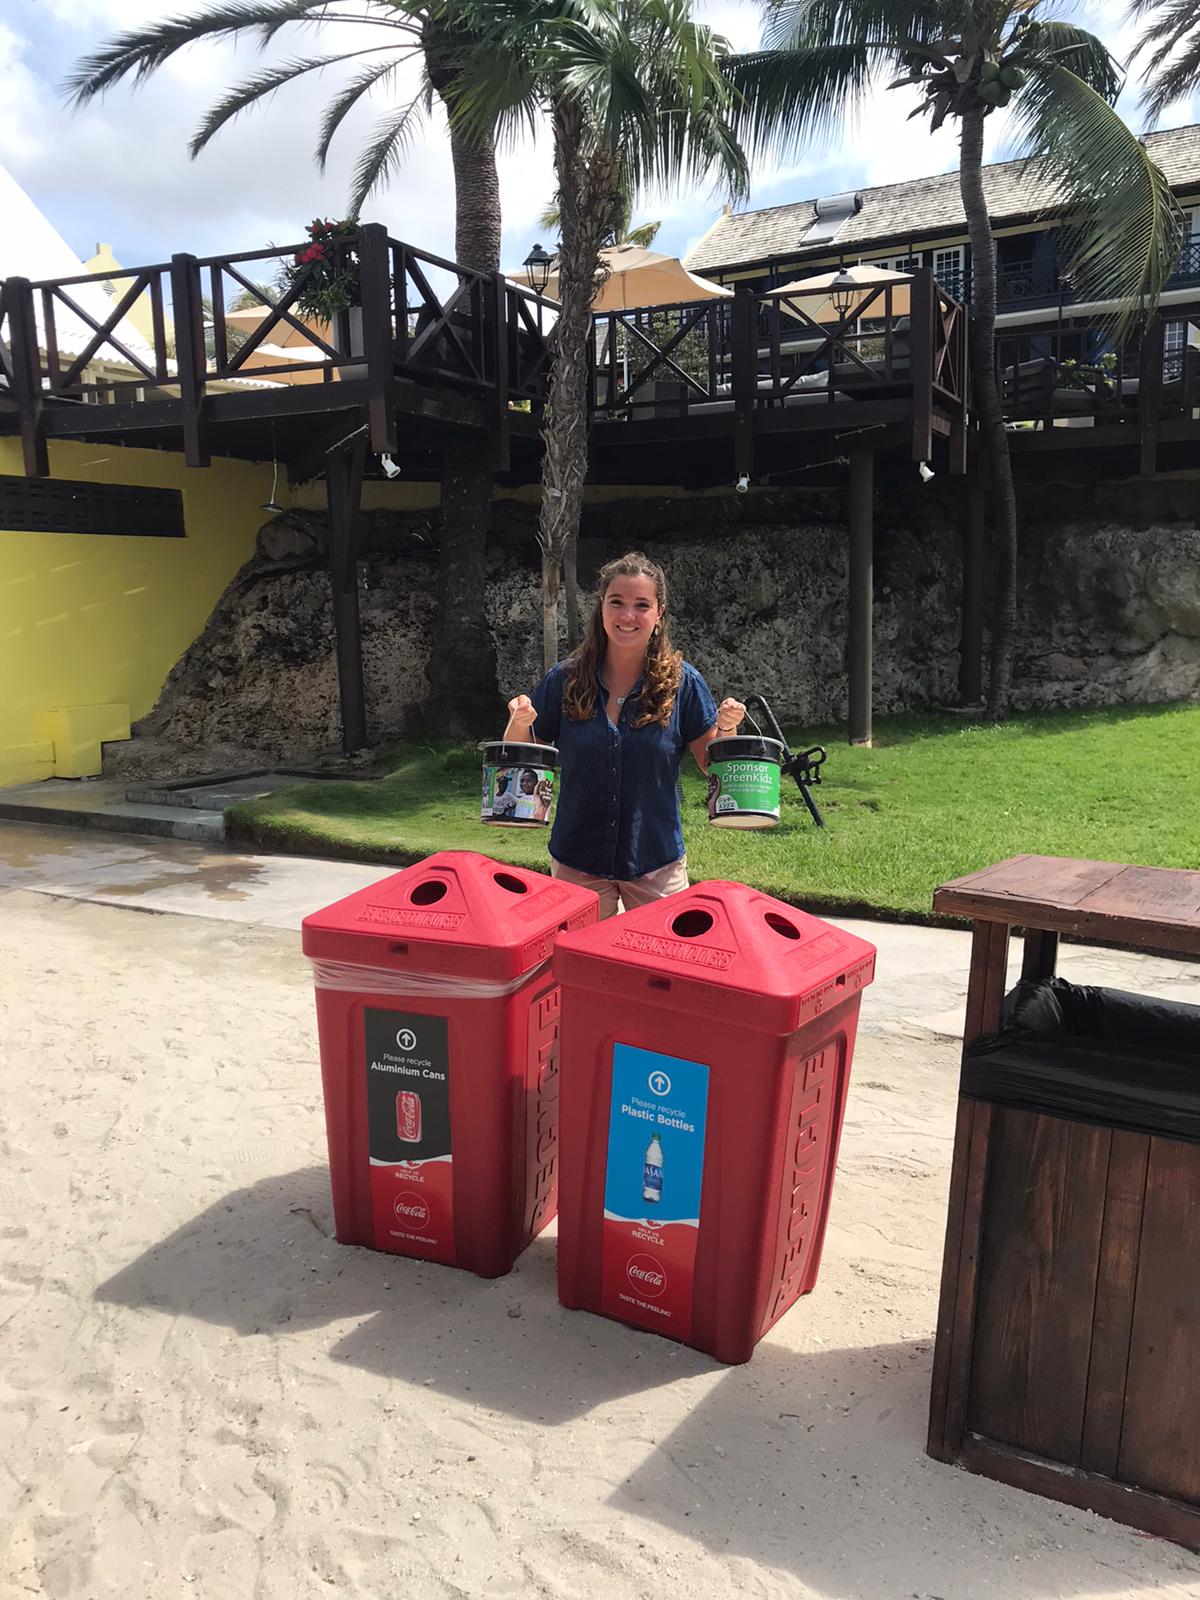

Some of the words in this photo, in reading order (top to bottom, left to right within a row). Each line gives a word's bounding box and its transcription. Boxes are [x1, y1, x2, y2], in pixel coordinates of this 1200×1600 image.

[727, 763, 768, 773] Sponsor
[722, 773, 773, 784] GreenKidz
[383, 1053, 405, 1063] Please
[406, 1058, 431, 1067] recycle
[371, 1062, 420, 1076] Aluminium
[422, 1069, 446, 1080] Cans
[529, 991, 558, 1235] RECYCLE
[631, 1096, 656, 1110] Please
[657, 1105, 686, 1118] recycle
[621, 1104, 655, 1121] Plastic
[657, 1114, 695, 1132] Bottles
[394, 1172, 425, 1183] RECYCLE
[770, 1050, 825, 1319] RECYCLE
[389, 1230, 405, 1238] TASTE
[631, 1230, 665, 1246] RECYCLE
[619, 1293, 636, 1304] TASTE
[636, 1300, 647, 1309] THE
